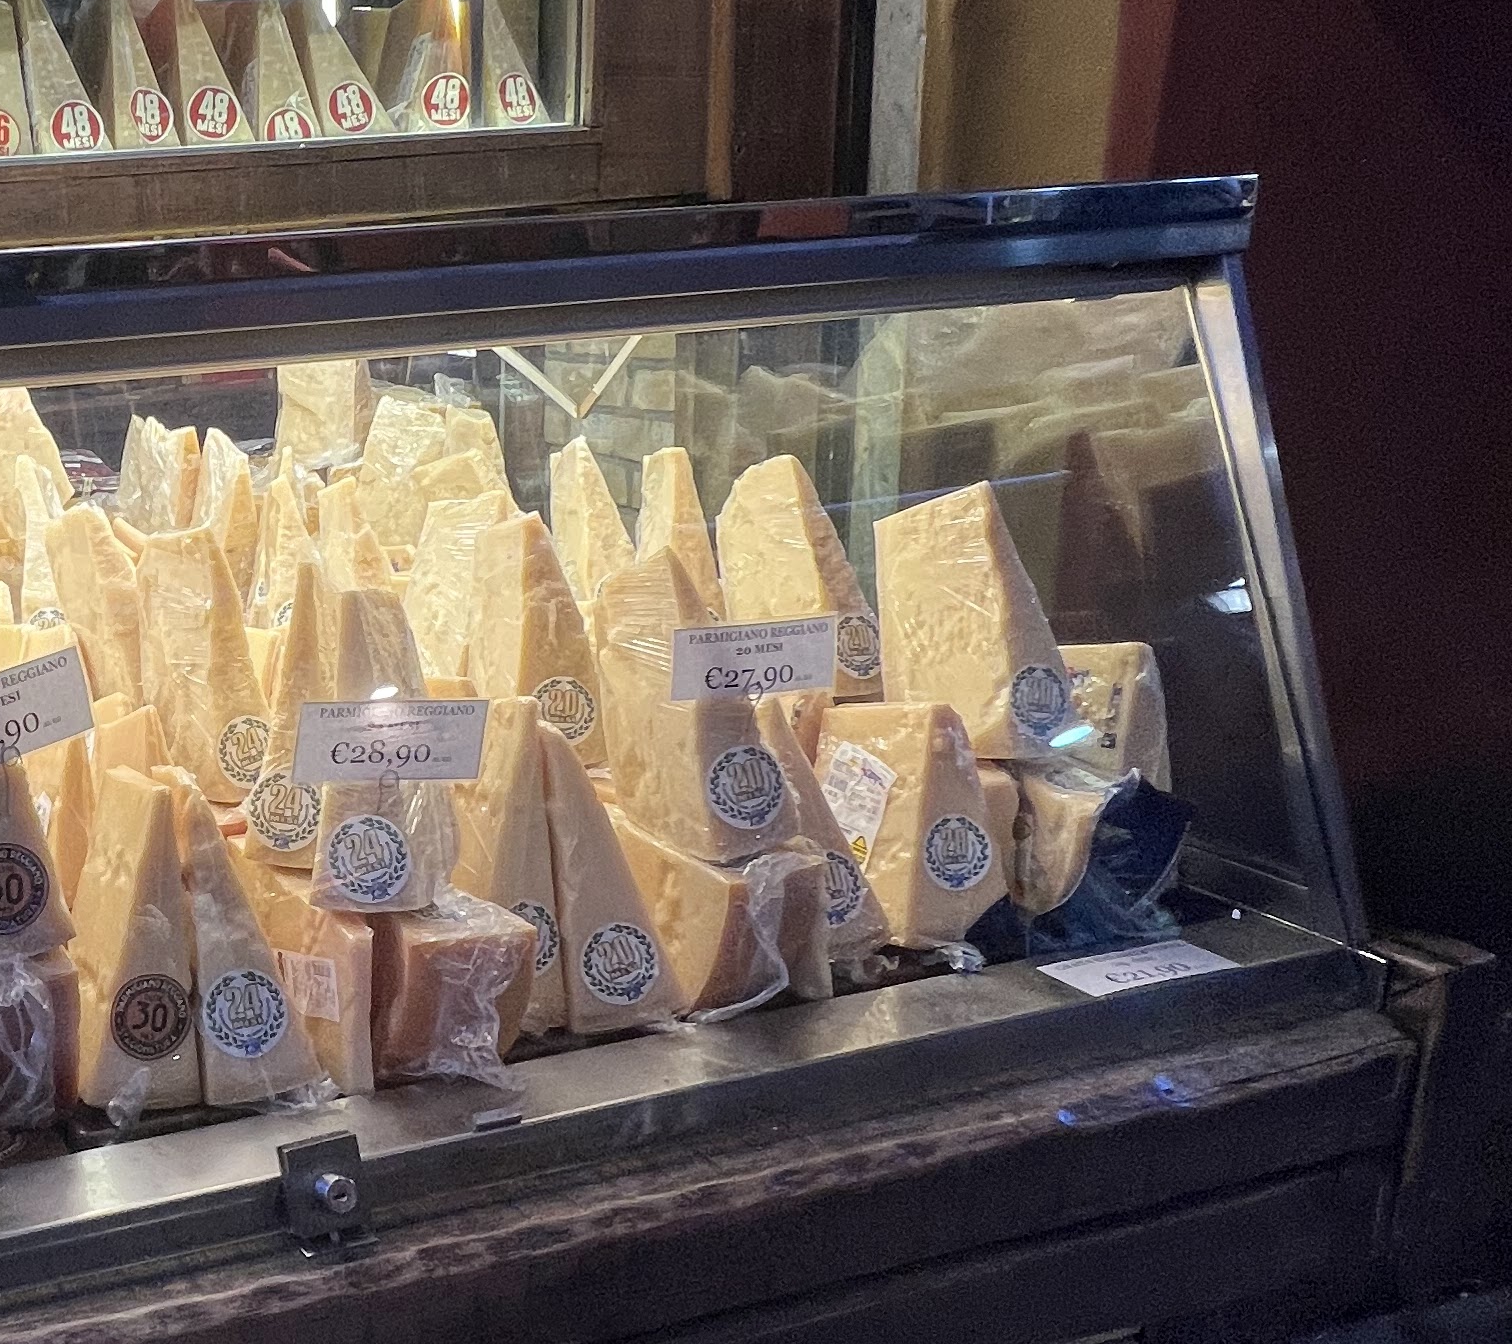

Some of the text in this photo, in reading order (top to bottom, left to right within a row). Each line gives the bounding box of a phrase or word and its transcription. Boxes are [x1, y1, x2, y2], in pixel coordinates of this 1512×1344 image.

[198, 90, 230, 122] 48
[336, 85, 364, 115] 48
[431, 78, 462, 107] 48
[505, 77, 530, 107] 48
[61, 105, 92, 138] 48
[135, 92, 160, 124] 48
[341, 112, 369, 130] MESI
[431, 106, 461, 121] MESI
[506, 104, 533, 118] MESI
[138, 122, 162, 137] MESI
[197, 119, 227, 135] MESI
[274, 111, 302, 140] 48
[63, 136, 94, 148] MESI
[689, 622, 829, 645] PARMIGIANO REGGIANO
[735, 642, 783, 656] 20 MESI
[0, 655, 68, 690] REGGIANO
[407, 705, 475, 717] REGGIANO
[548, 688, 581, 716] 20
[231, 726, 263, 759] 24
[330, 739, 431, 768] €28,90
[726, 757, 766, 792] 20
[268, 783, 303, 815] 24
[344, 828, 386, 868] 24
[224, 983, 263, 1019] 24
[132, 1001, 168, 1032] 30
